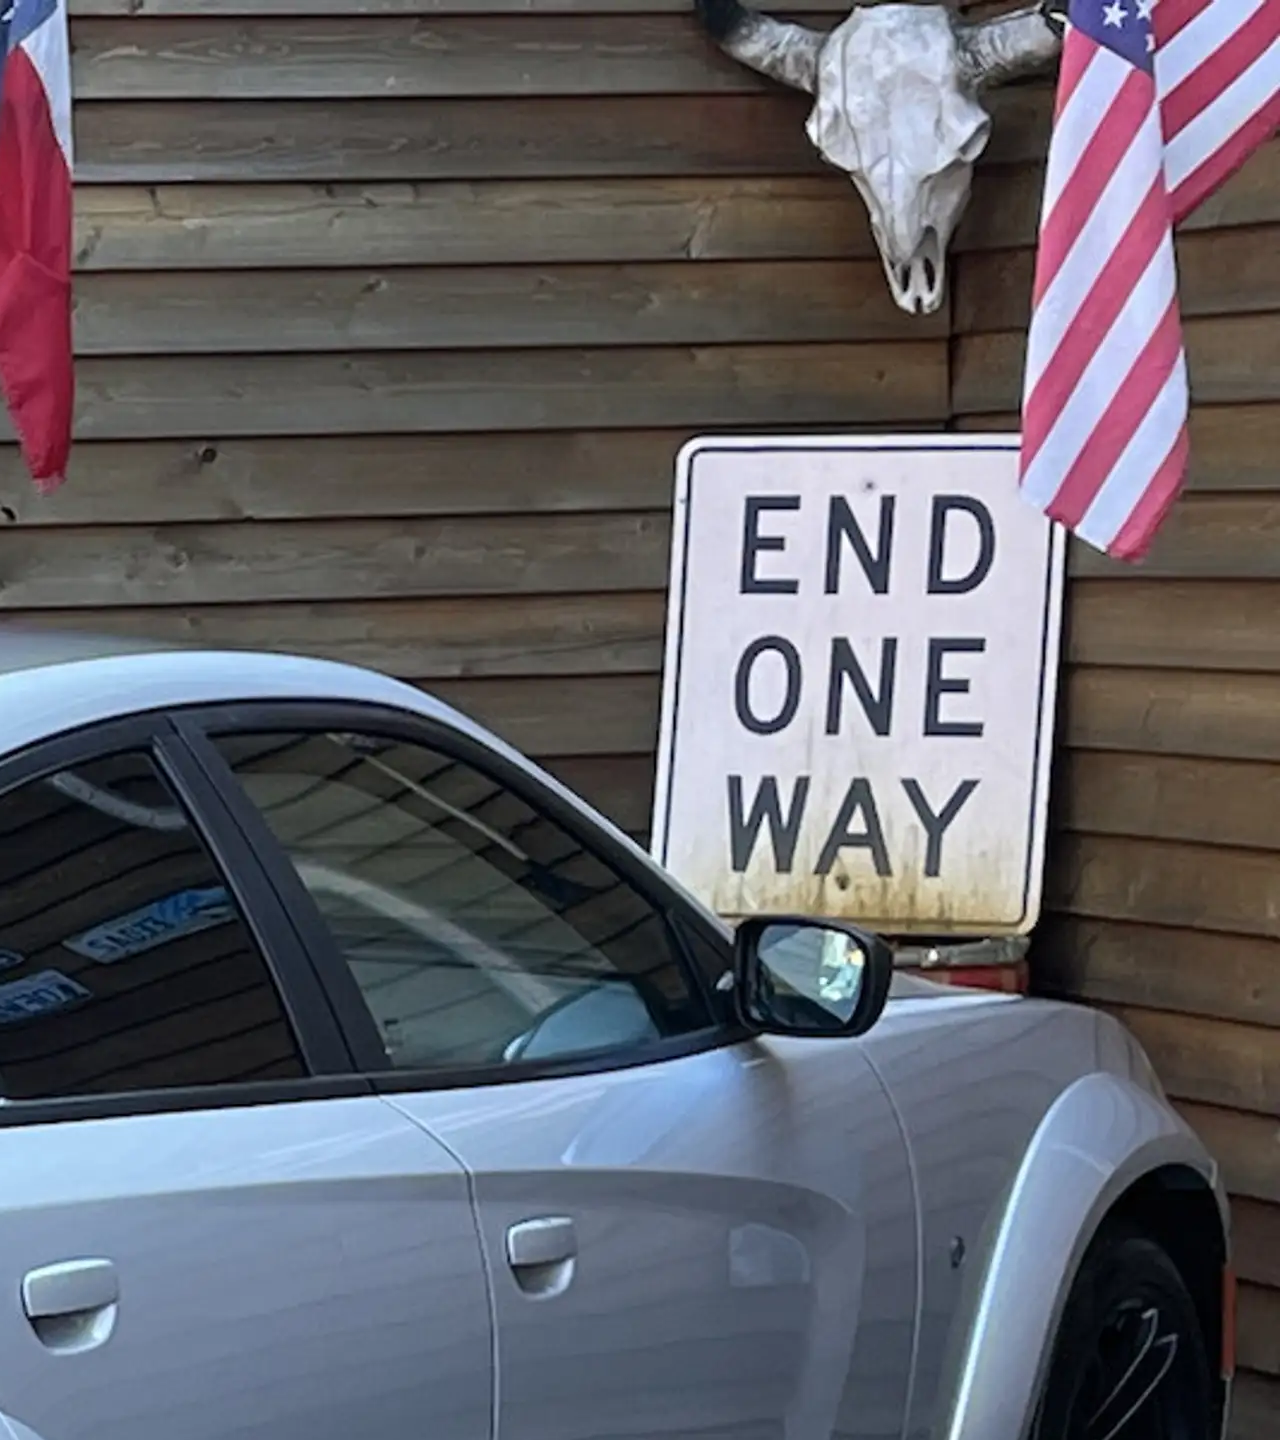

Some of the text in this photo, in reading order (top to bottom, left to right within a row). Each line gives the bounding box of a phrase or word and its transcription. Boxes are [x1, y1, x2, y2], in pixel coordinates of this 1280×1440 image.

[739, 494, 996, 595] END
[734, 635, 987, 738] ONE
[726, 775, 981, 878] WAY
